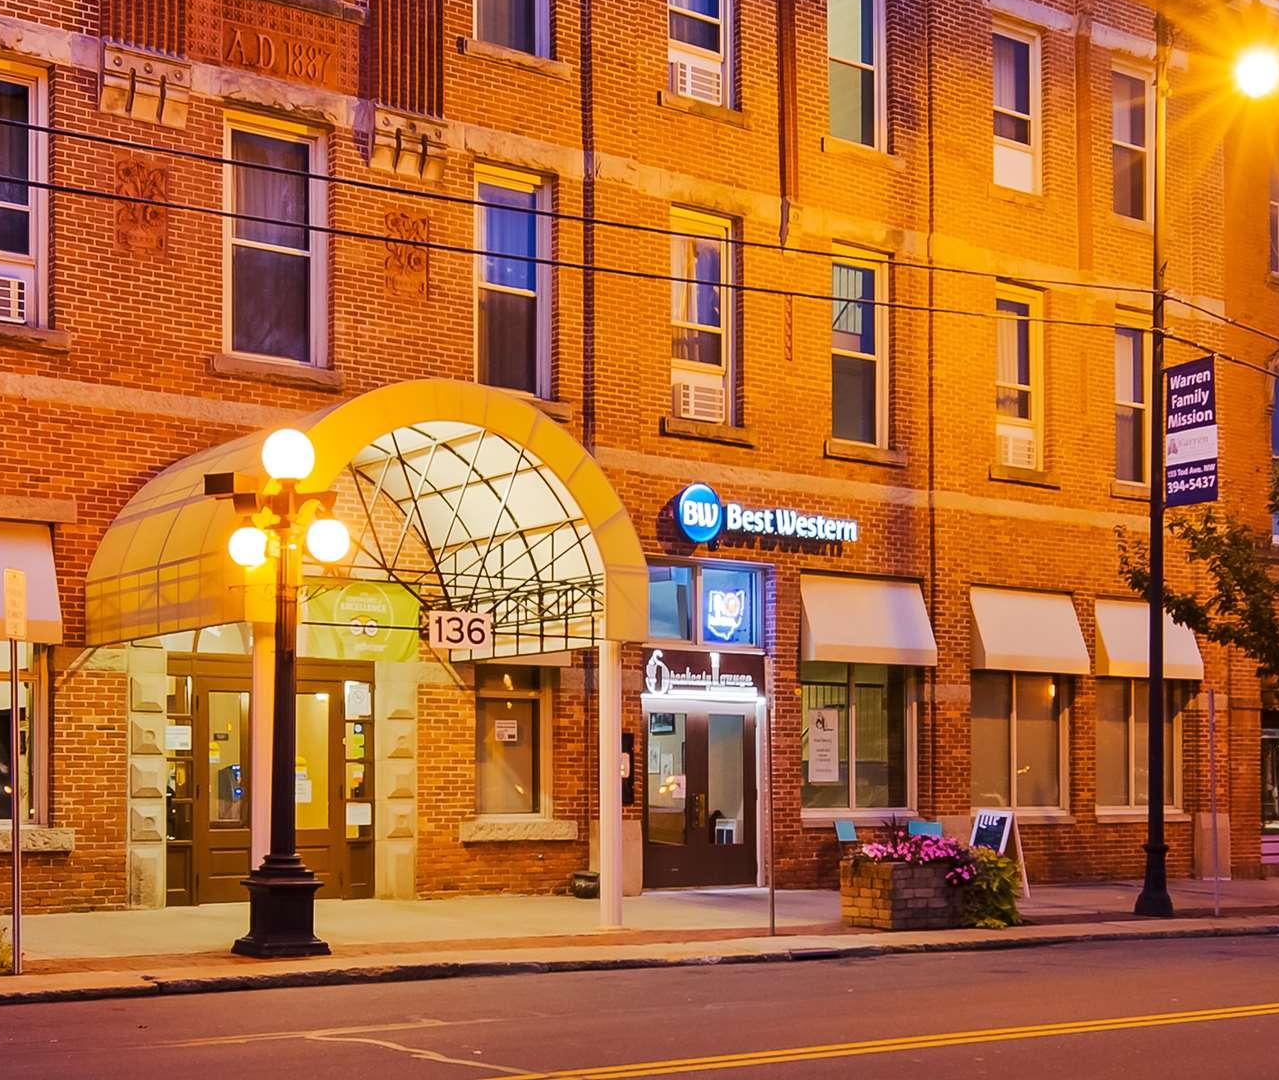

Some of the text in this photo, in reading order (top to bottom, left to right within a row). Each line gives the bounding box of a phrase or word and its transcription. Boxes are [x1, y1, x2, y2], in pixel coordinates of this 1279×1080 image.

[283, 39, 332, 84] 1887
[1170, 370, 1211, 390] Warren
[1171, 389, 1210, 409] Family
[1168, 408, 1213, 429] Mission
[683, 500, 858, 541] BW Best Western
[435, 616, 486, 644] 136
